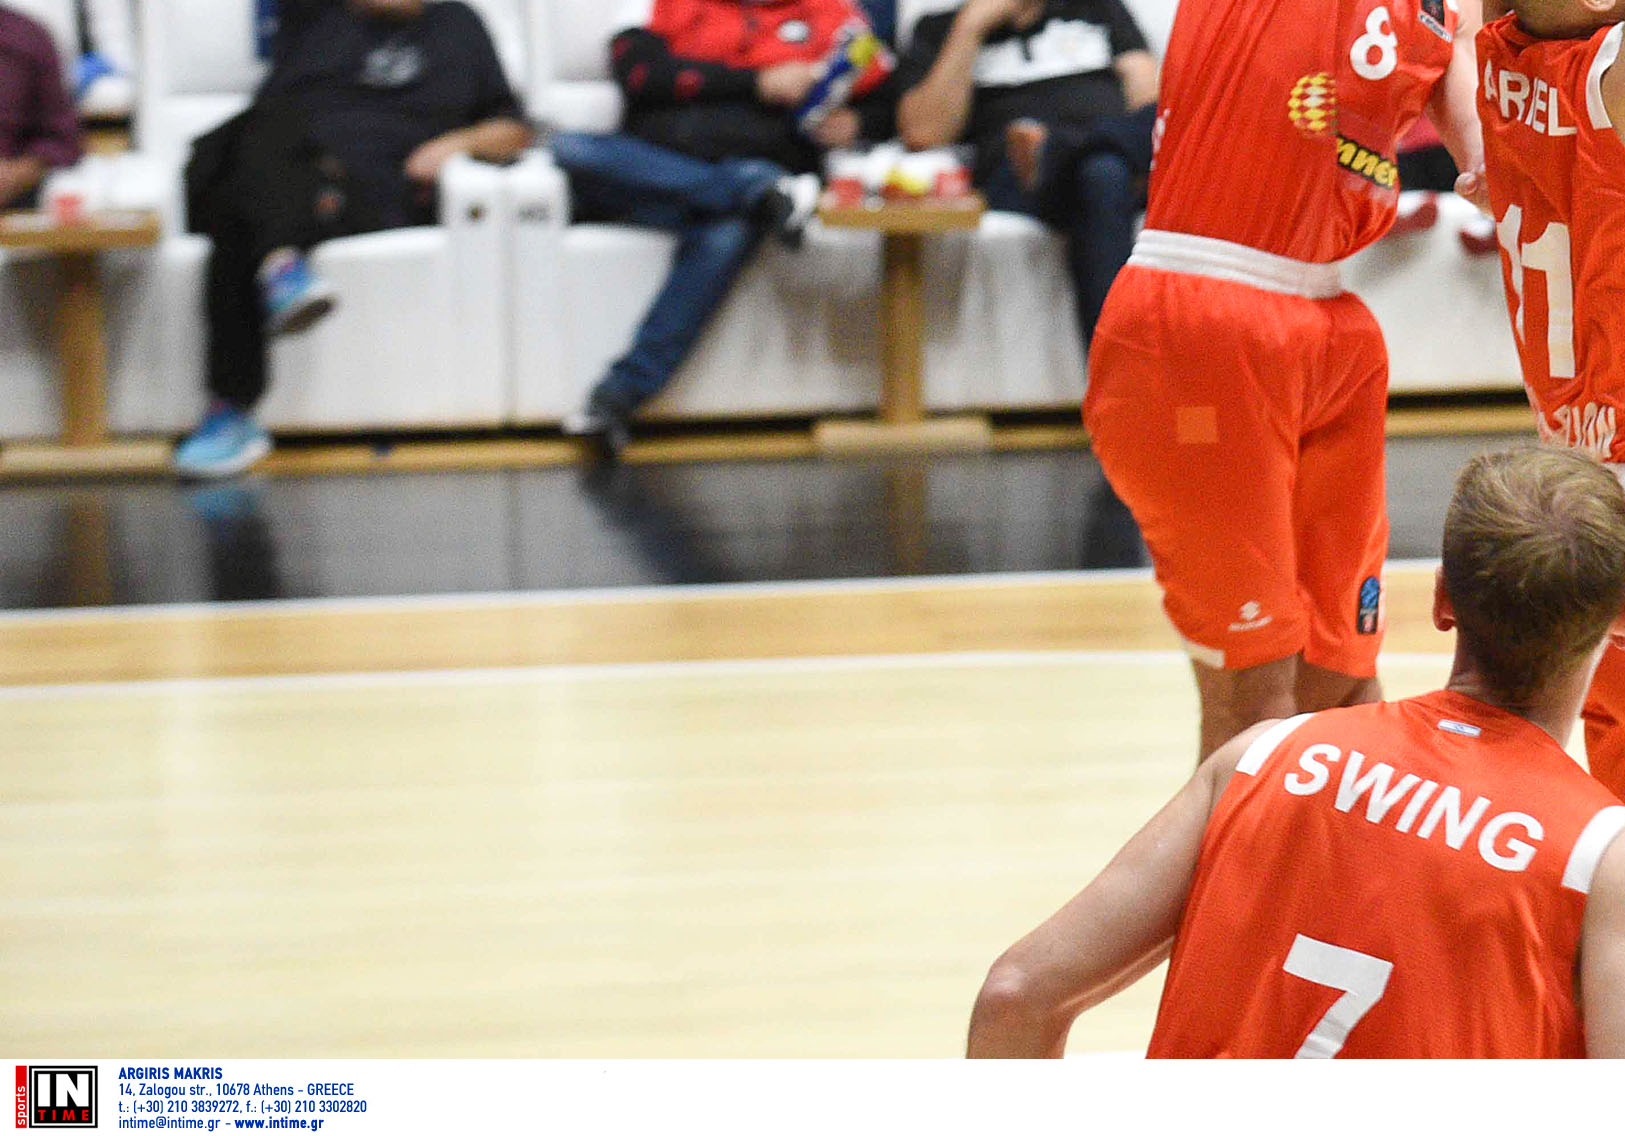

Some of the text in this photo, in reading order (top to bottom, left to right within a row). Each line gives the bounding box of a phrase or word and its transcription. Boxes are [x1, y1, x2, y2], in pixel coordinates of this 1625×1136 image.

[1350, 6, 1398, 81] 8
[1496, 203, 1576, 379] 11
[1283, 742, 1545, 872] SWING
[1282, 932, 1394, 1059] 7
